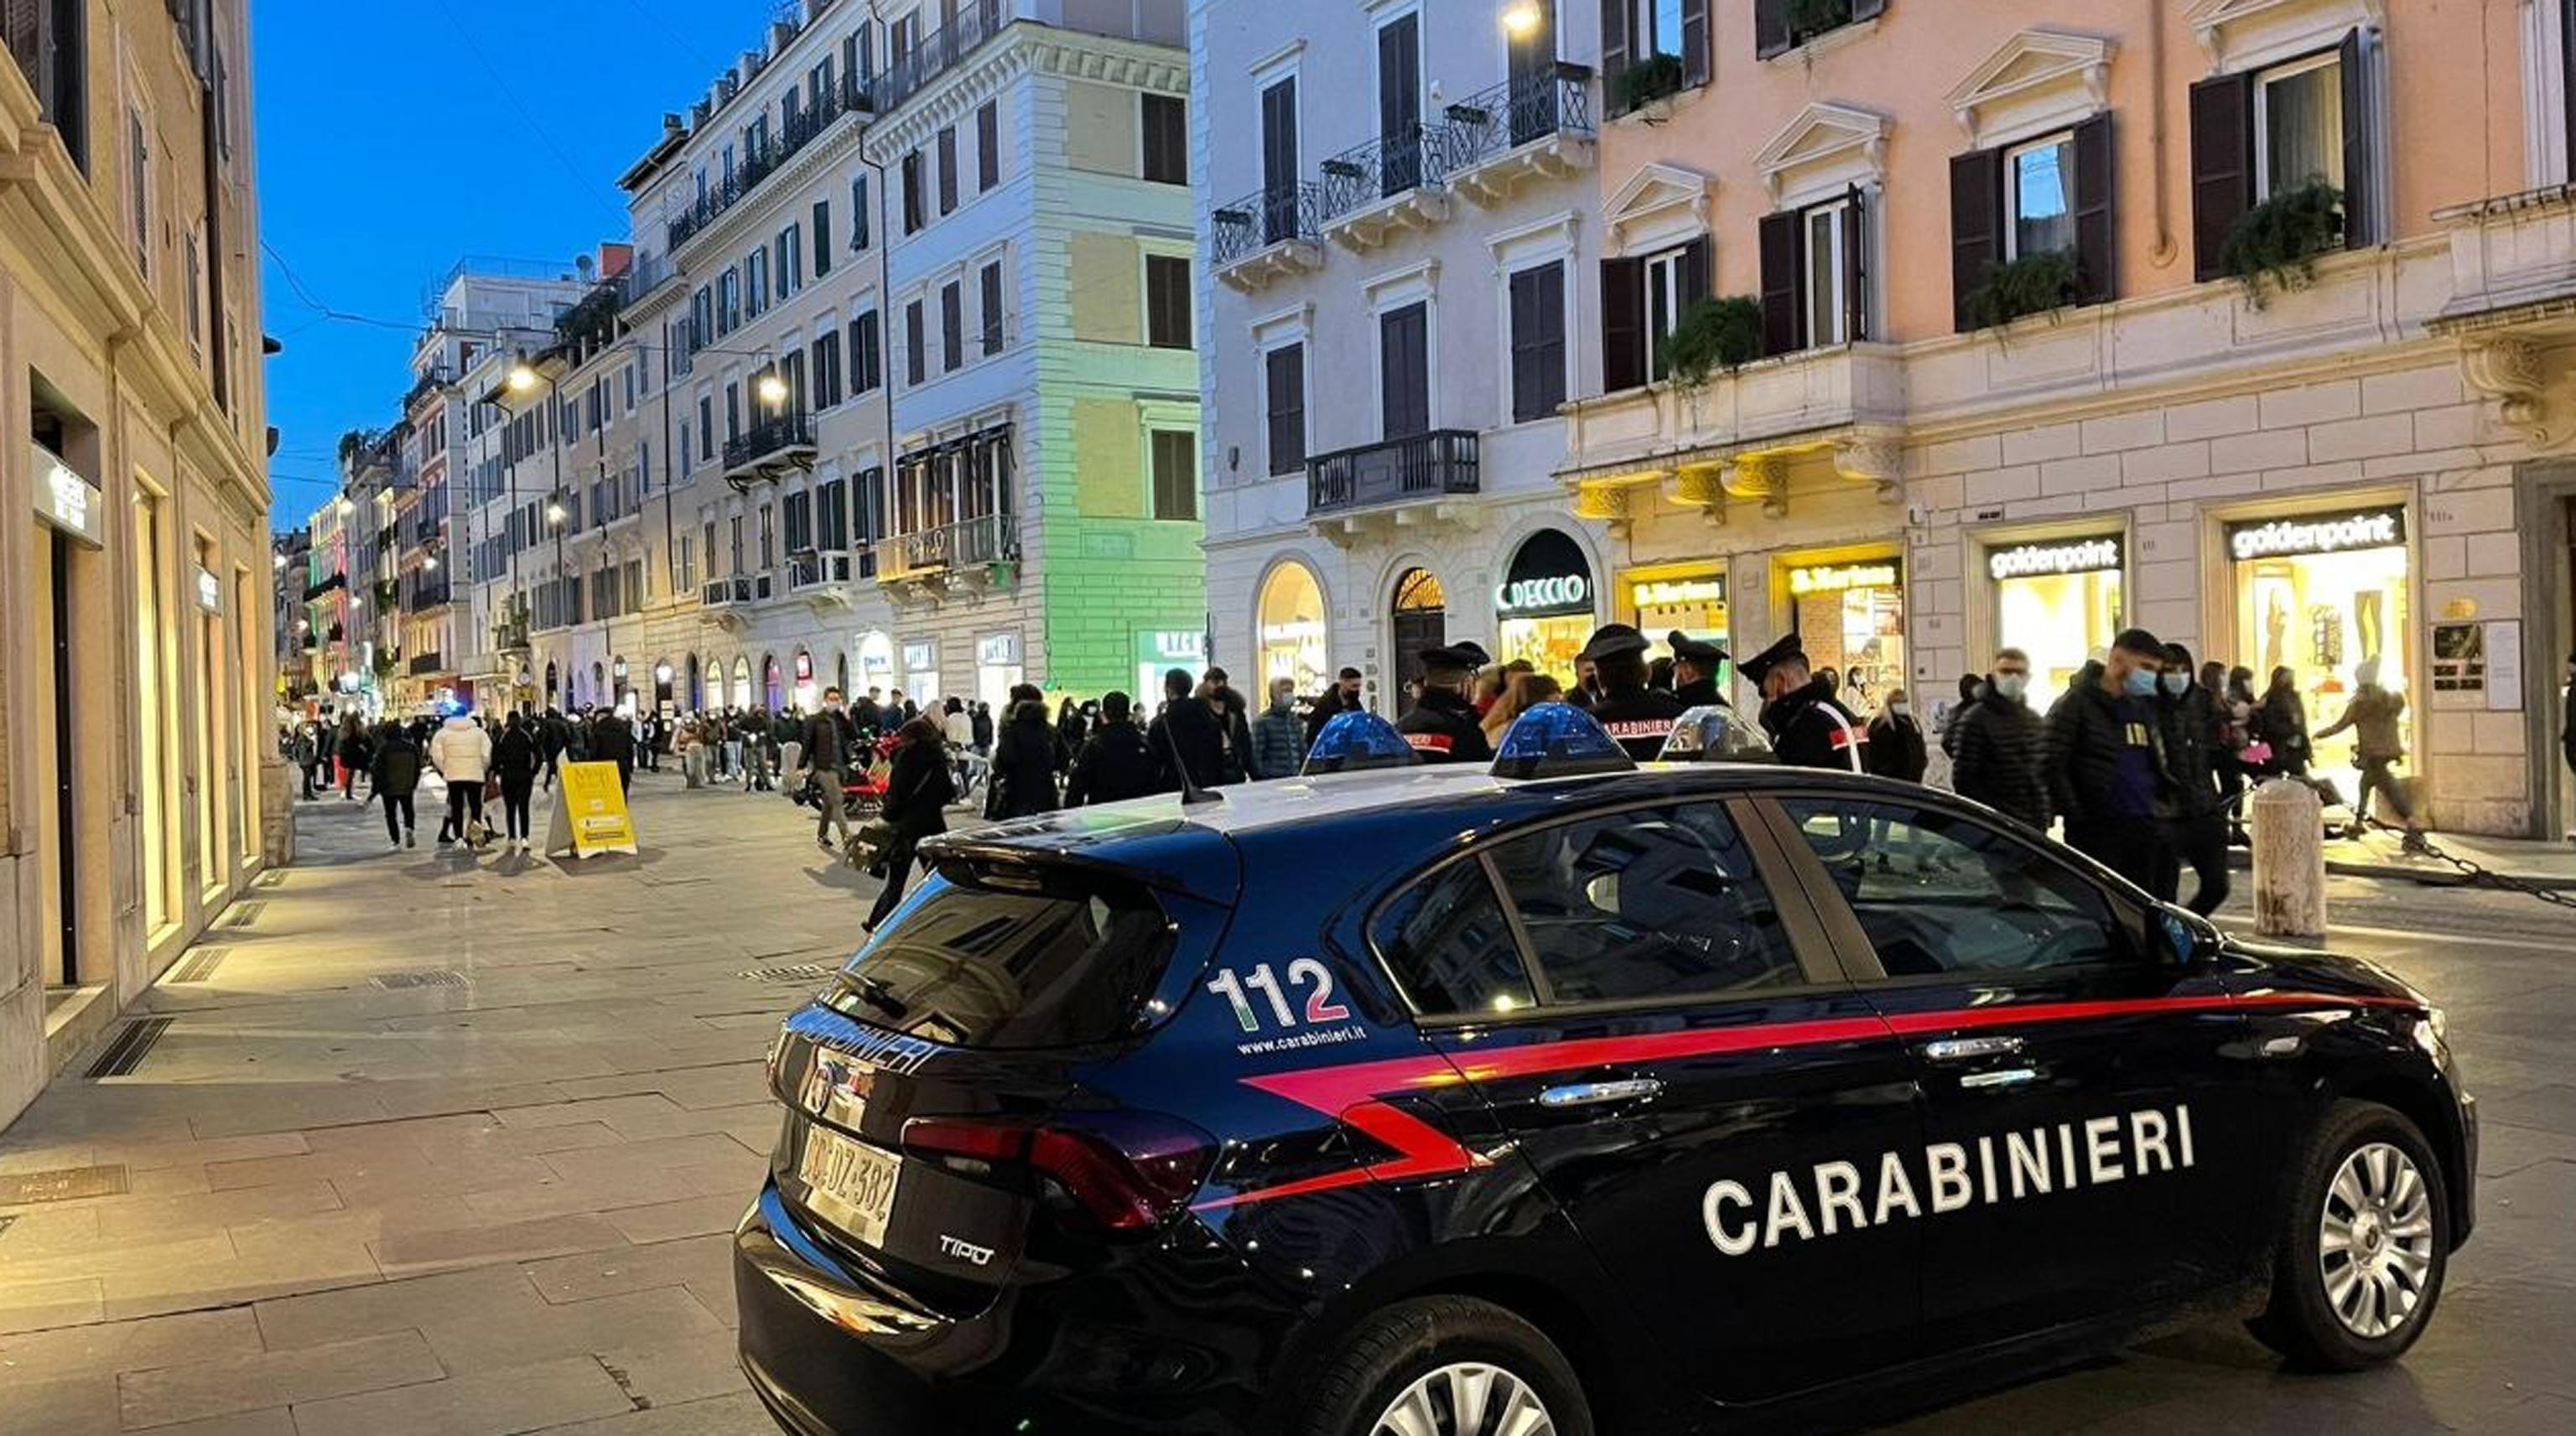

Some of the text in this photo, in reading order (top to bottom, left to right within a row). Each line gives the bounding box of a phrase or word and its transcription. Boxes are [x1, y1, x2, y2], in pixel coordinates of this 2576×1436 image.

[2233, 514, 2394, 558] goldenpoint
[1991, 540, 2117, 579] goldenpoint
[1208, 958, 1350, 1031] 112
[1237, 1025, 1367, 1055] www.carabinieri.it
[1702, 1105, 2194, 1257] CARABINIERI
[940, 1234, 995, 1265] TIPO
